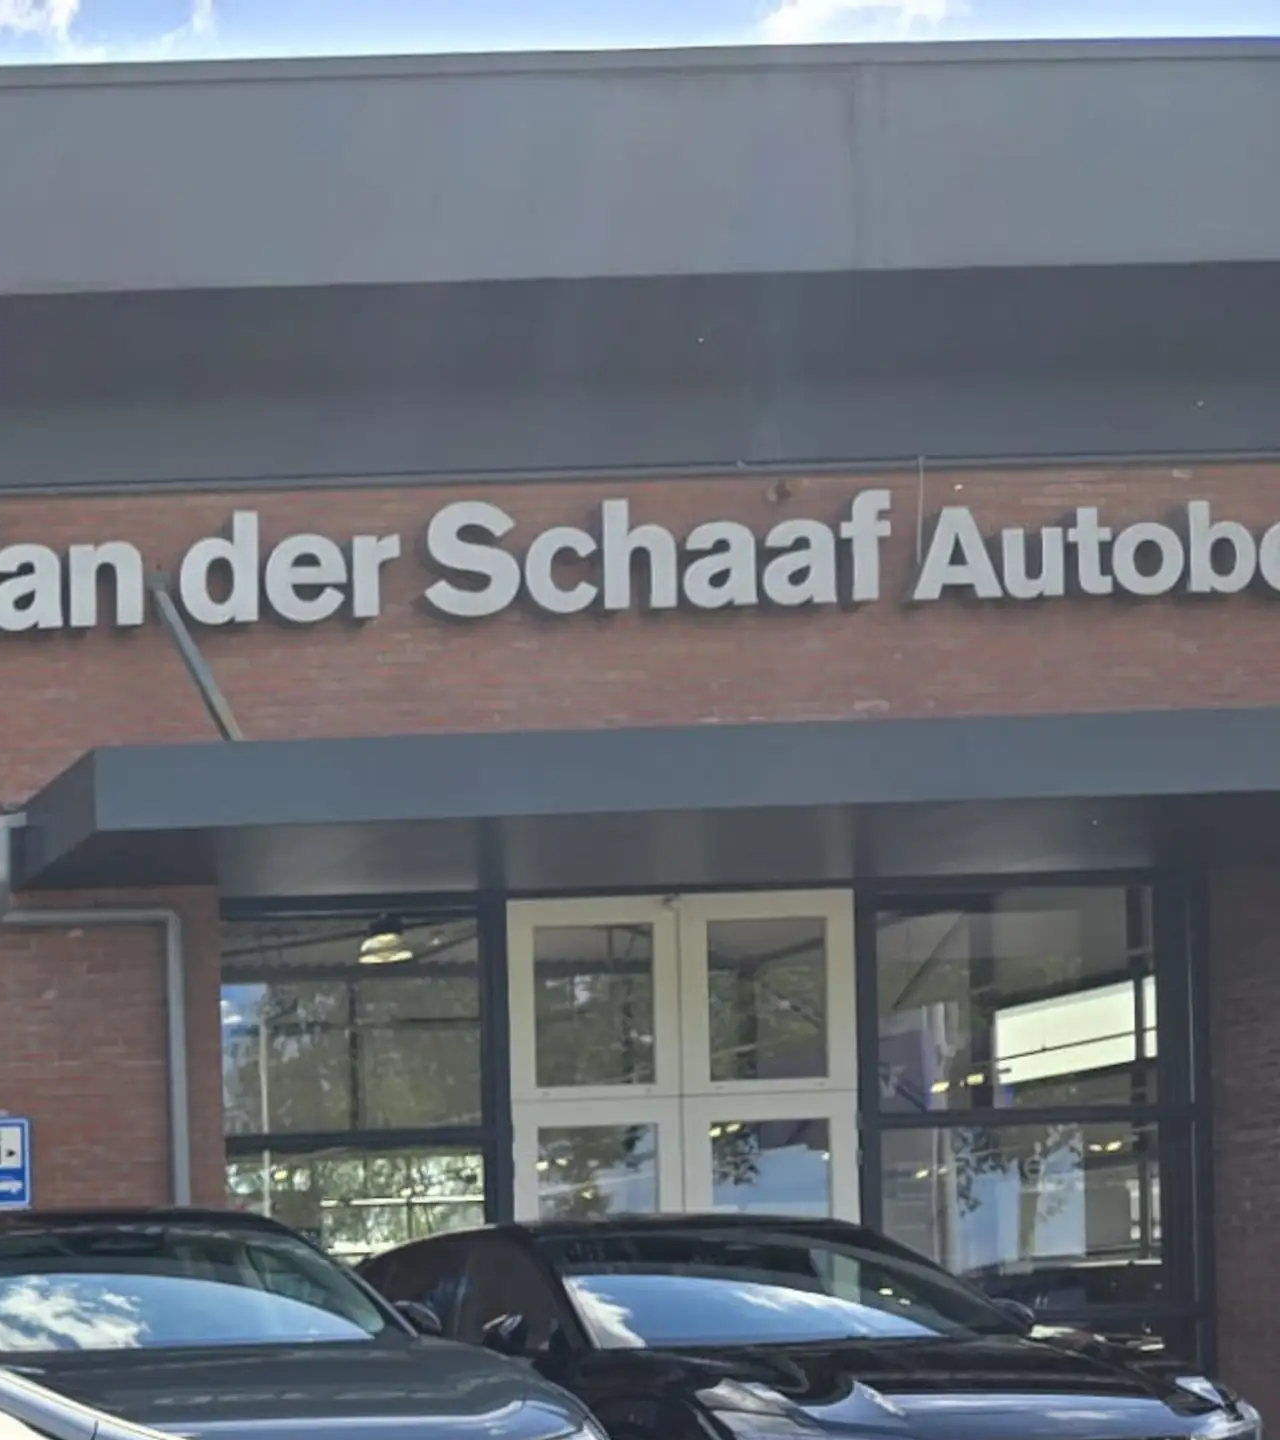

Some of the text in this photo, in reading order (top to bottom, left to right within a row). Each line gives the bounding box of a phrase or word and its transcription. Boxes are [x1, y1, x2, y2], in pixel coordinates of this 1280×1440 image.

[179, 509, 401, 626] der
[424, 488, 892, 618] Schaaf
[912, 499, 1280, 601] Autob
